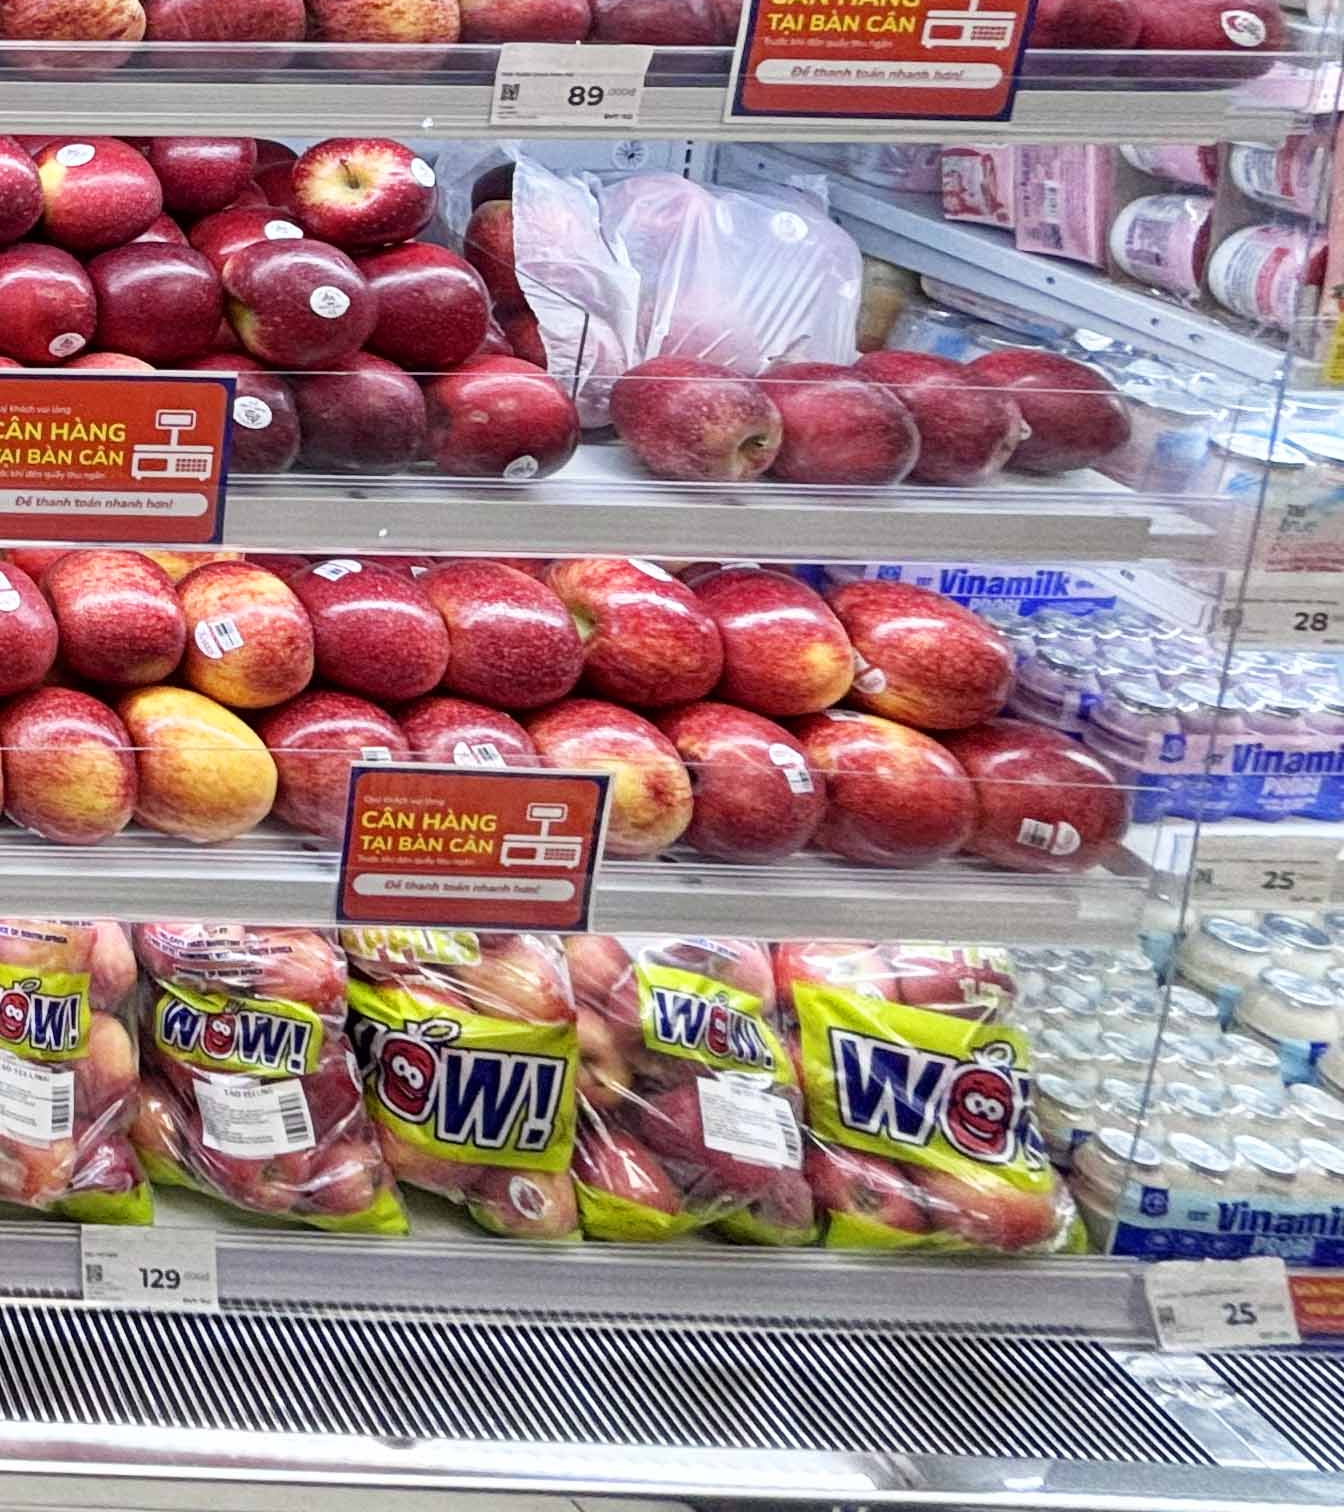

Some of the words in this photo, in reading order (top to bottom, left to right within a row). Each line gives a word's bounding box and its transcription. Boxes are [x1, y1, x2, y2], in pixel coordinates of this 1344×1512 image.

[767, 13, 804, 35] TẠI
[809, 8, 860, 32] BÀN
[866, 10, 916, 33] CÂN
[566, 85, 605, 106] 89
[50, 417, 126, 442] HÀNG
[27, 444, 72, 465] BÀN
[79, 446, 124, 466] CÂN
[938, 569, 1071, 598] Vinamilk
[1293, 612, 1329, 632] 28
[1232, 740, 1344, 775] Vinami
[361, 807, 415, 830] CÂN
[422, 808, 497, 832] HÀNG
[361, 835, 393, 856] TẠI
[398, 831, 443, 853] BÀN
[449, 833, 494, 854] CÂN
[1261, 870, 1296, 890] 25
[138, 1266, 182, 1290] 129
[1222, 1301, 1256, 1326] 25
